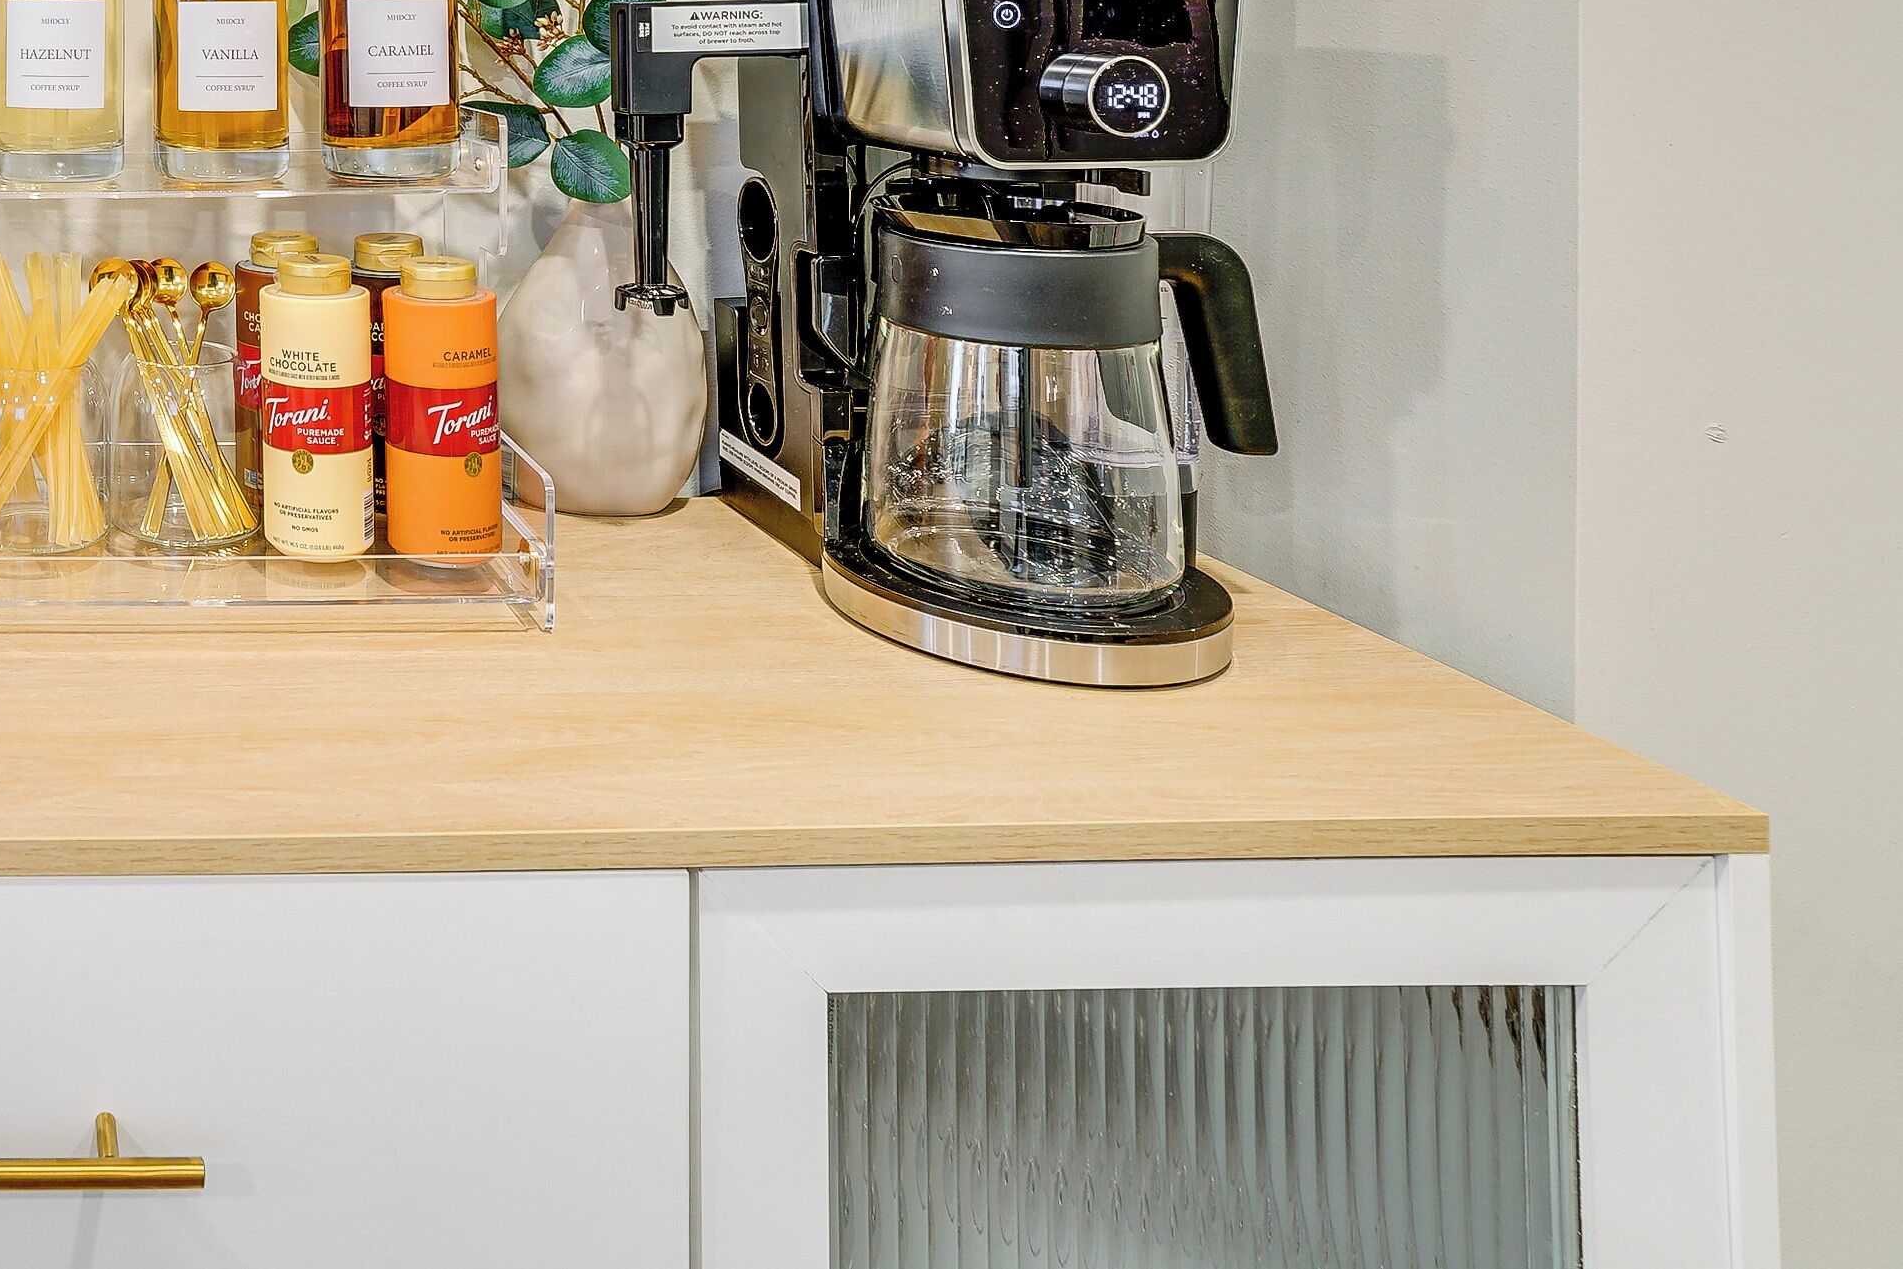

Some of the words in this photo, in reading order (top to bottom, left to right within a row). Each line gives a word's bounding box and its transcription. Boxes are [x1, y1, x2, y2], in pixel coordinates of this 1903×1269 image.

[700, 9, 763, 21] WARNING:
[19, 48, 92, 60] HAZELNUT
[201, 48, 259, 60] VANILLA
[367, 44, 434, 57] CARAMEL
[57, 84, 81, 92] SYRUP
[205, 84, 232, 92] COFFEE
[234, 84, 256, 92] SYRUP
[406, 80, 428, 88] SYRUP
[1108, 83, 1158, 109] 12:48
[281, 348, 320, 362] WHITE
[443, 347, 492, 362] CARAMEL
[269, 356, 337, 373] CHOCOLATE
[265, 397, 329, 434] Torani
[427, 394, 493, 445] Torani
[296, 427, 345, 437] PUREMADE
[306, 436, 337, 445] SAUCE
[281, 504, 311, 514] ARTIFICIAL
[287, 511, 333, 521] PRESERVATIVES
[452, 527, 482, 536] ARTIFICIAL
